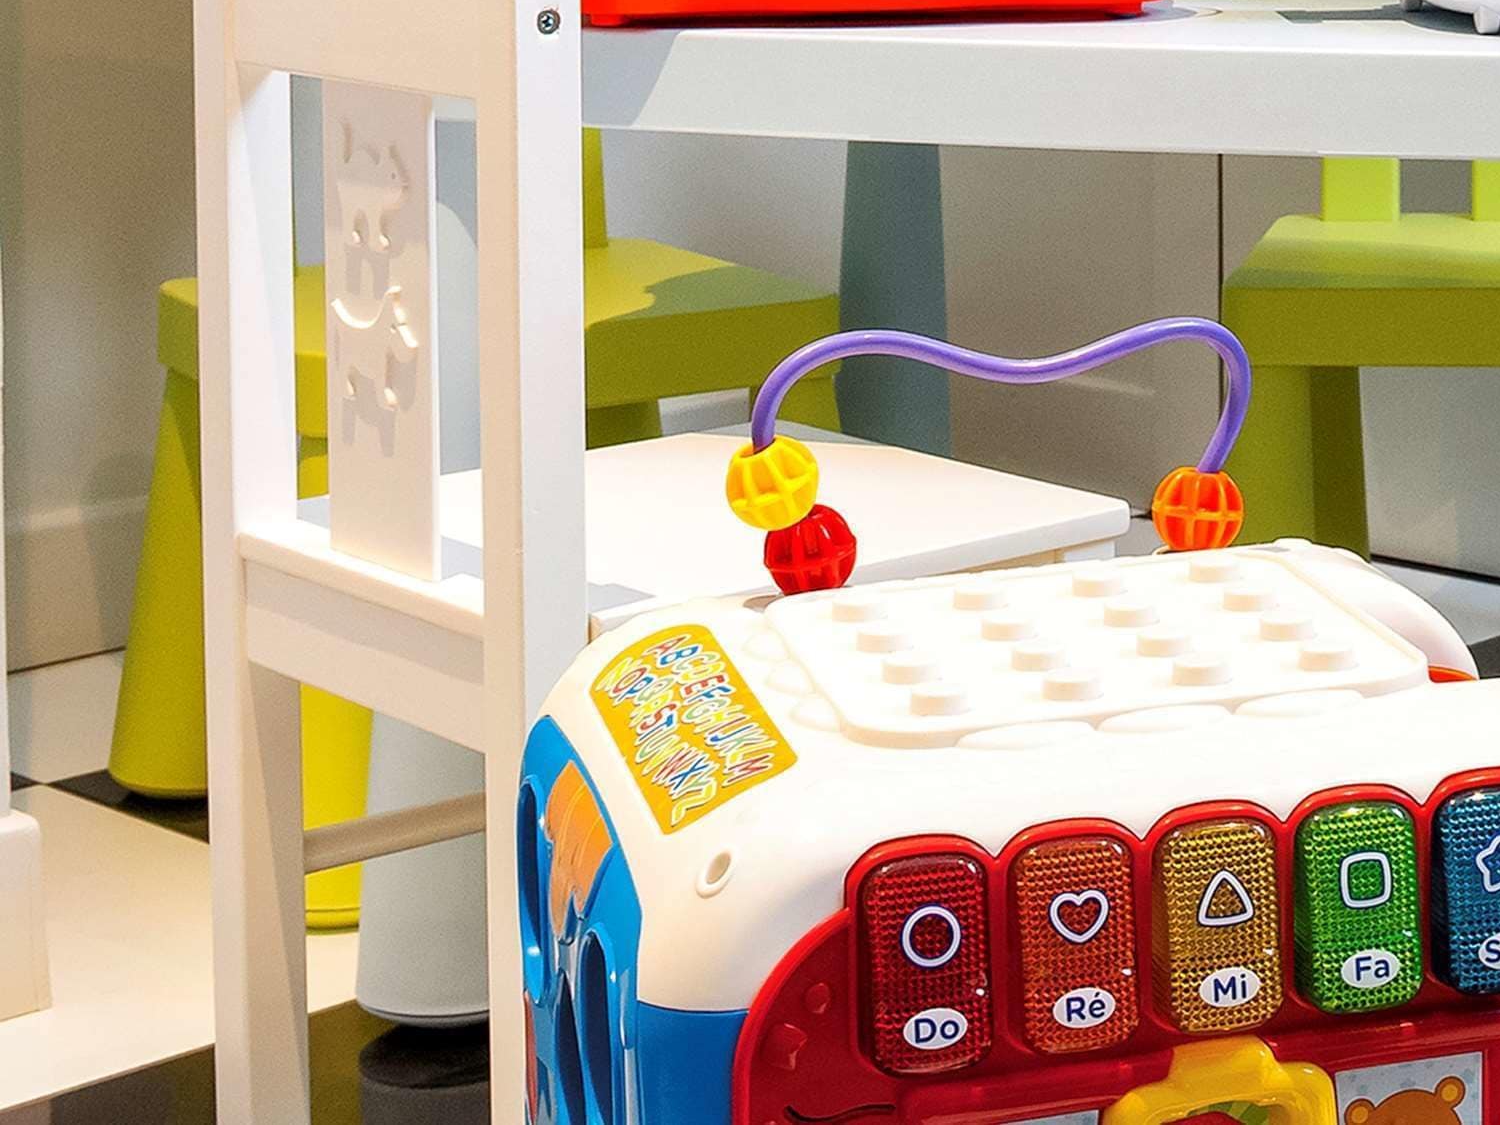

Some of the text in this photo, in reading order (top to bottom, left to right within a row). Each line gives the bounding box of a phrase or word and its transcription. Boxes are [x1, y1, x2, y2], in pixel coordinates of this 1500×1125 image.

[1354, 955, 1391, 982] Fa
[1213, 974, 1247, 1004] Mi
[1066, 991, 1107, 1022] Ré
[914, 1017, 960, 1044] Do
